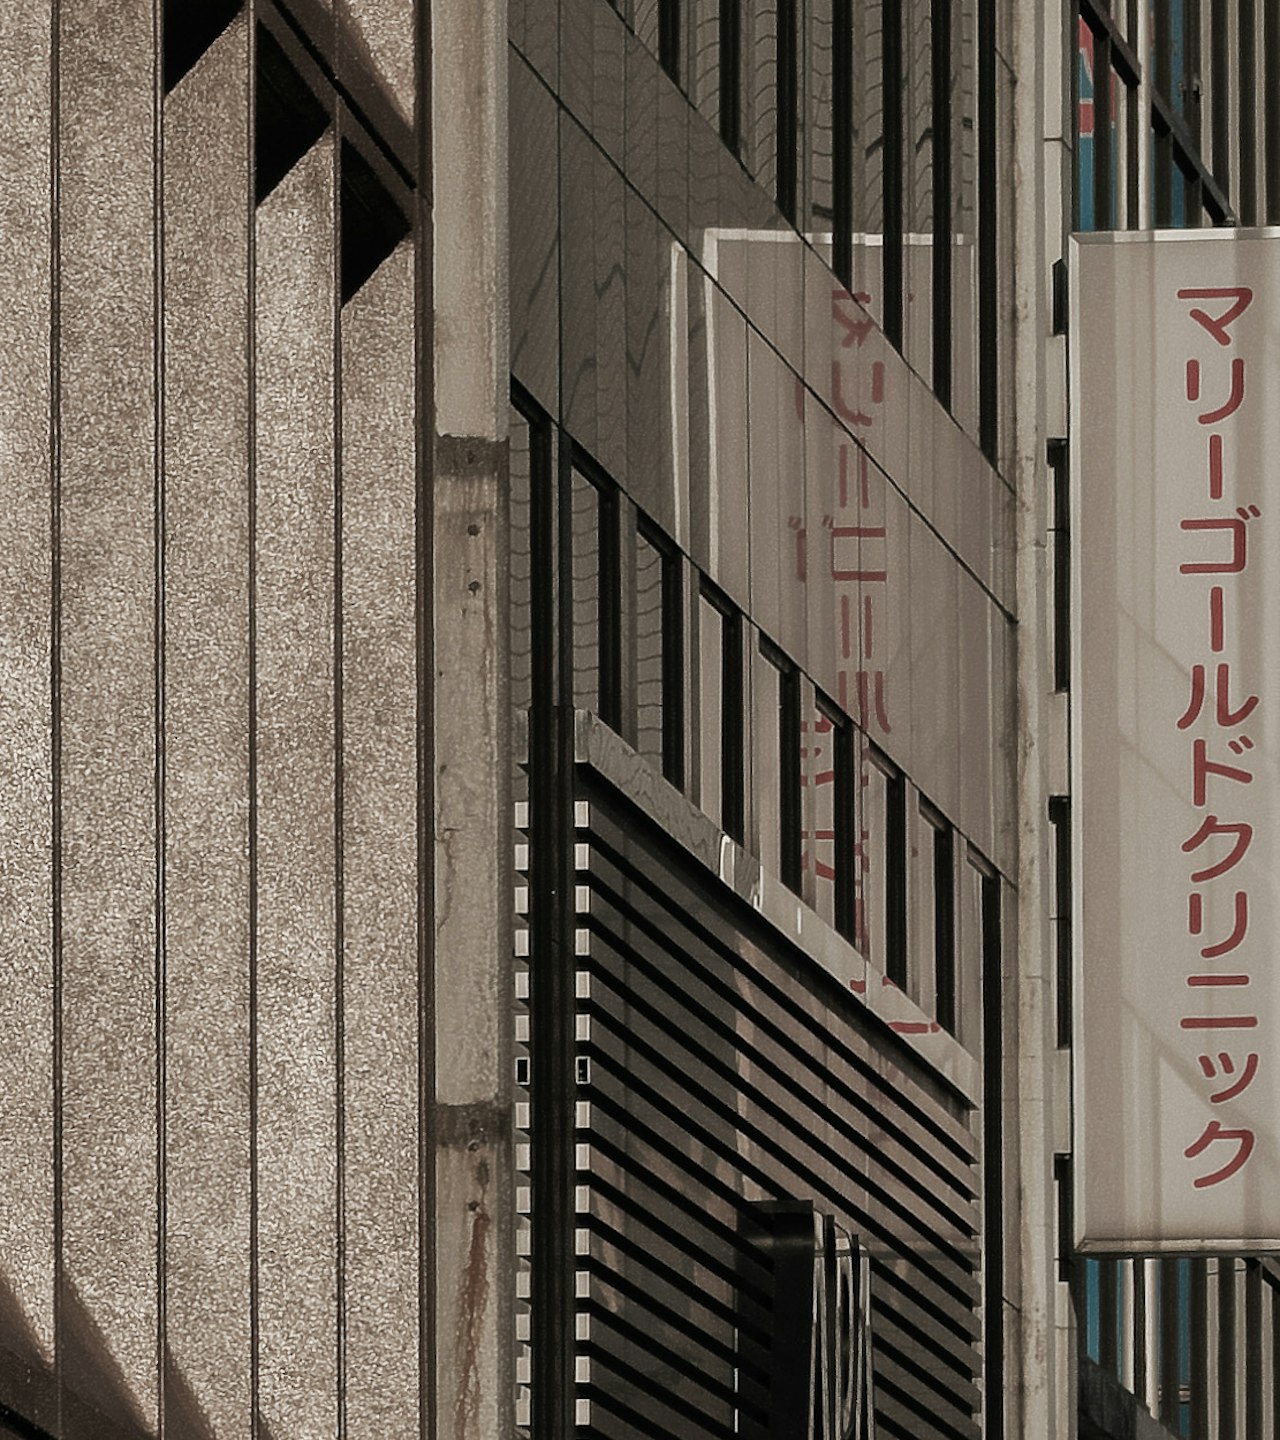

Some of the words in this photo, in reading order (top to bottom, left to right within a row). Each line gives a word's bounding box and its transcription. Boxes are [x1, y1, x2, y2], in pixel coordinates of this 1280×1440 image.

[1177, 286, 1261, 1190] マリーゴールドクリニック
